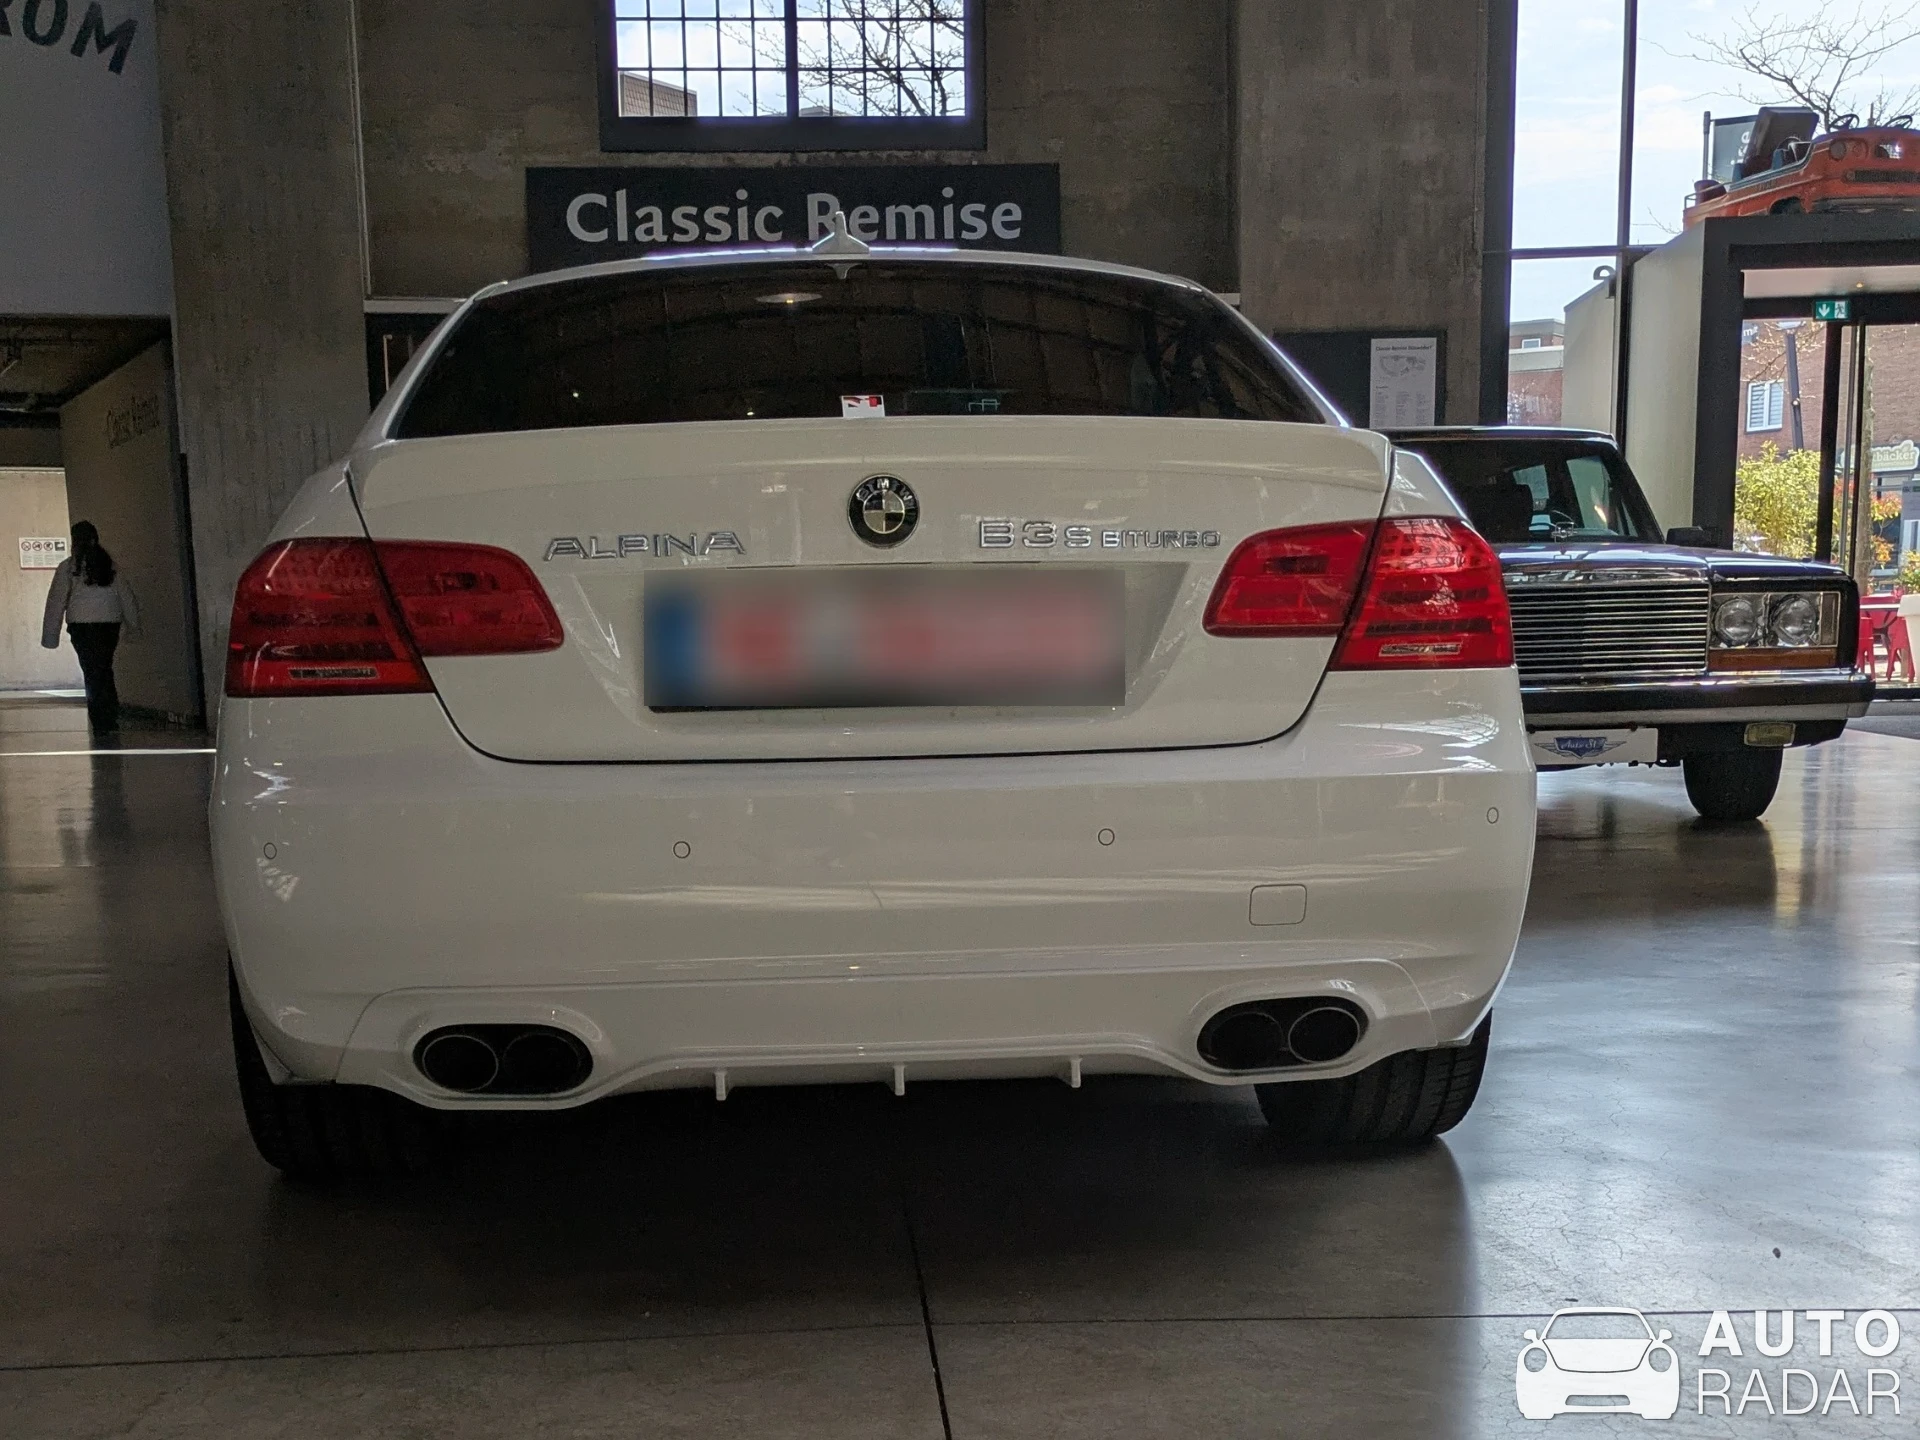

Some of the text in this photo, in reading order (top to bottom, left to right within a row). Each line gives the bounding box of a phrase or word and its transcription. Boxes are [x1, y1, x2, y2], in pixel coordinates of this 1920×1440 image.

[566, 187, 1022, 243] Classic Remise
[856, 478, 915, 510] BMW
[542, 531, 746, 562] ALPINA
[1101, 530, 1221, 548] BITURBO
